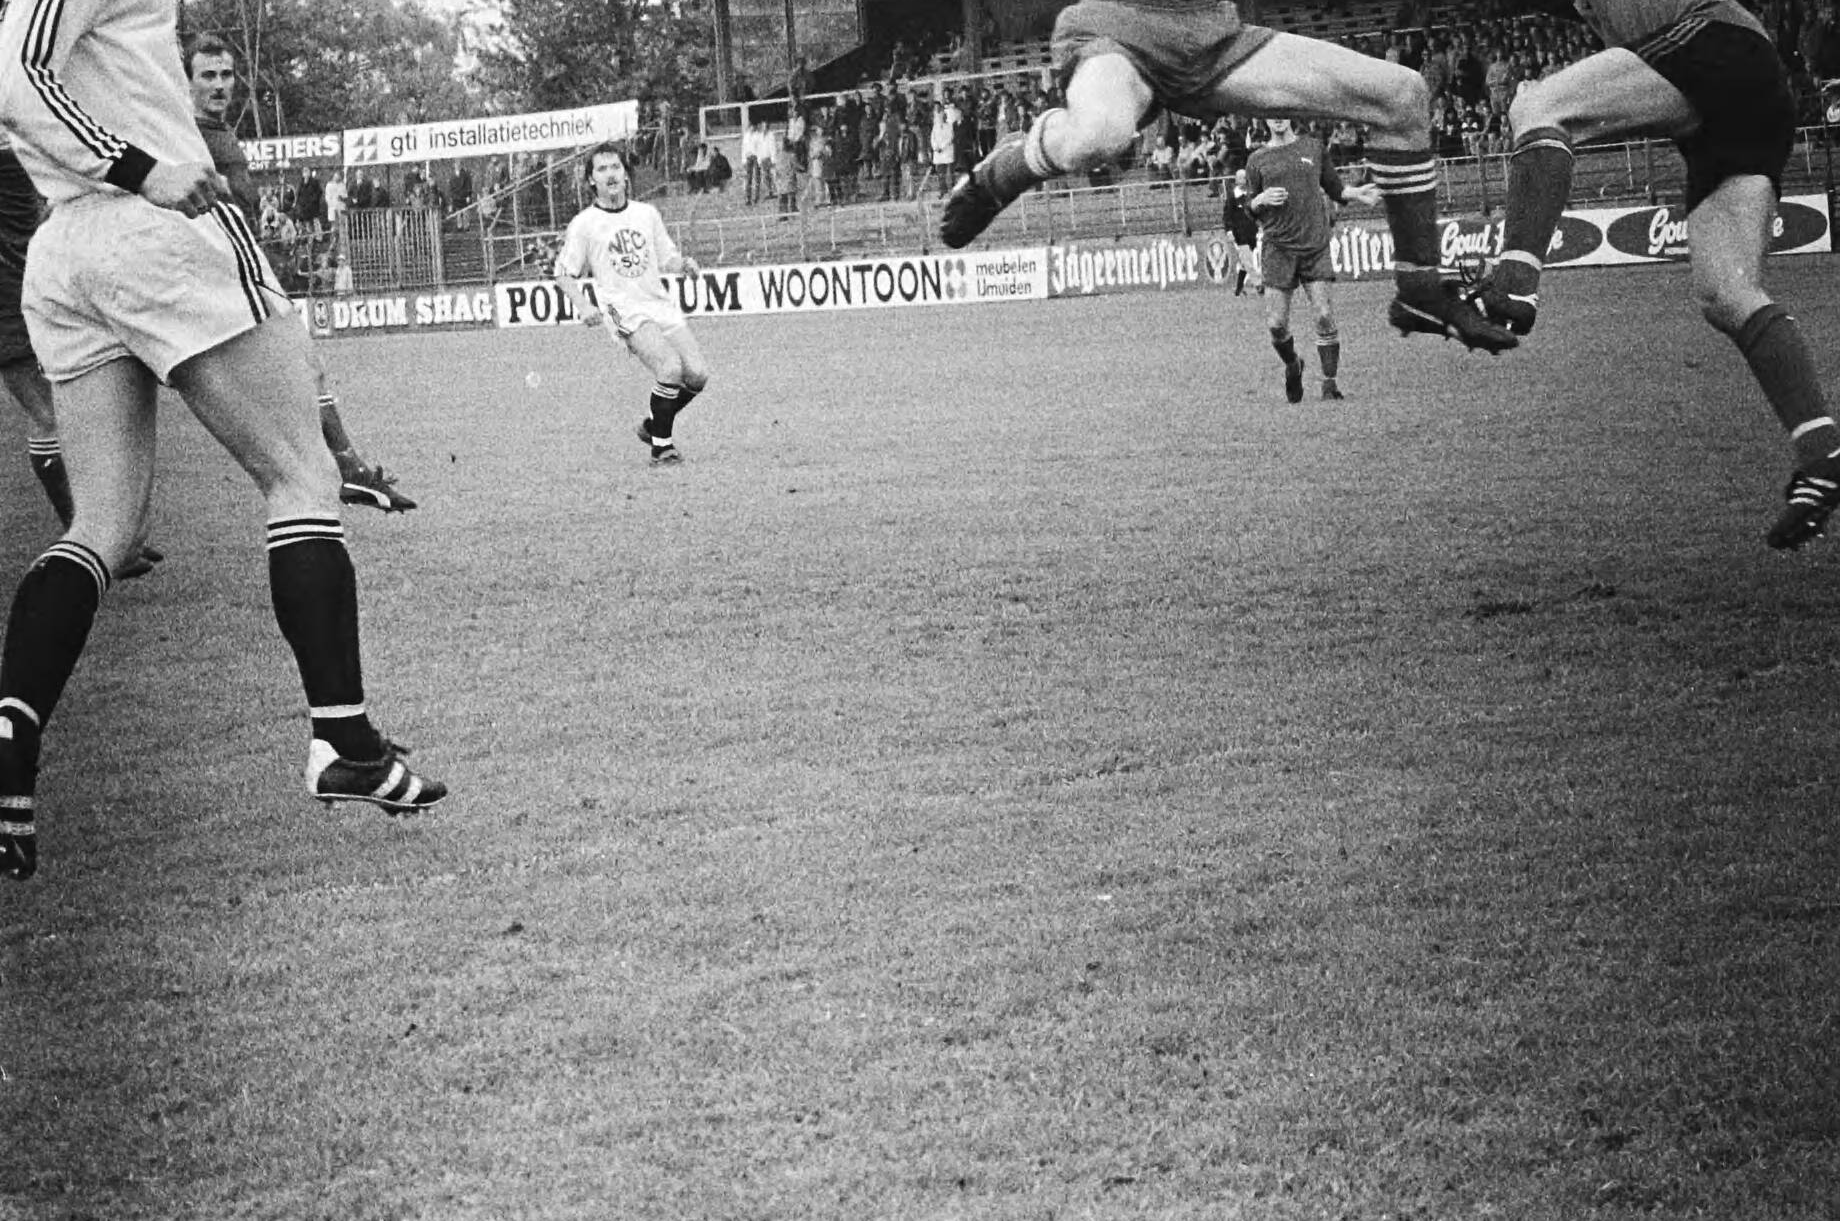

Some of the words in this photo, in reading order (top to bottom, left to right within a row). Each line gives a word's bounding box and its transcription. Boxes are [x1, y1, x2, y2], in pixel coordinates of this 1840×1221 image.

[390, 131, 417, 157] gti
[429, 112, 594, 149] installatietechniek
[1440, 221, 1491, 266] Goud
[1648, 208, 1688, 254] Gou
[759, 260, 941, 309] WOONTOON
[976, 254, 1036, 275] meubelen
[333, 297, 408, 329] DRUM
[416, 293, 493, 324] SHAG
